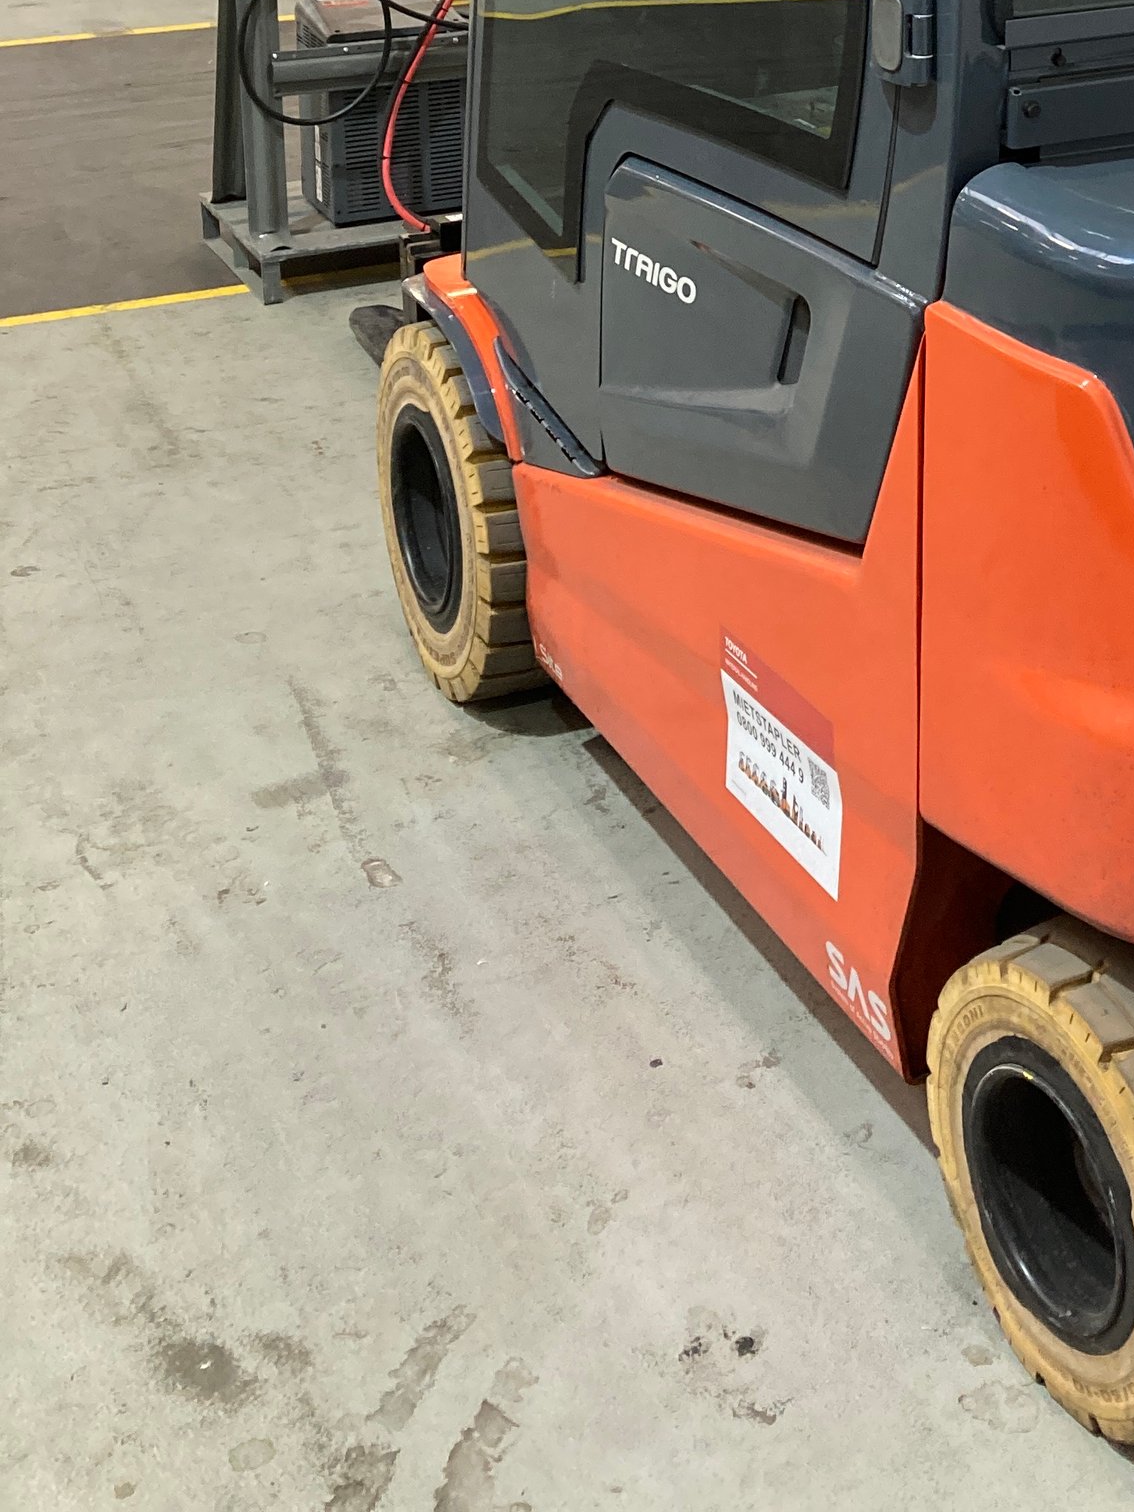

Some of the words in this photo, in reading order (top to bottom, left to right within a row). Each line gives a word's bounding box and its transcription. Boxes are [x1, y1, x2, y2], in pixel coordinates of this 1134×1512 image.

[724, 636, 748, 664] TOYOTA
[732, 689, 802, 760] MIETSTAPLER
[736, 711, 758, 741] 0800
[760, 734, 777, 758] 999
[779, 751, 796, 776] 444
[798, 767, 804, 784] 9
[825, 940, 891, 1041] SAS
